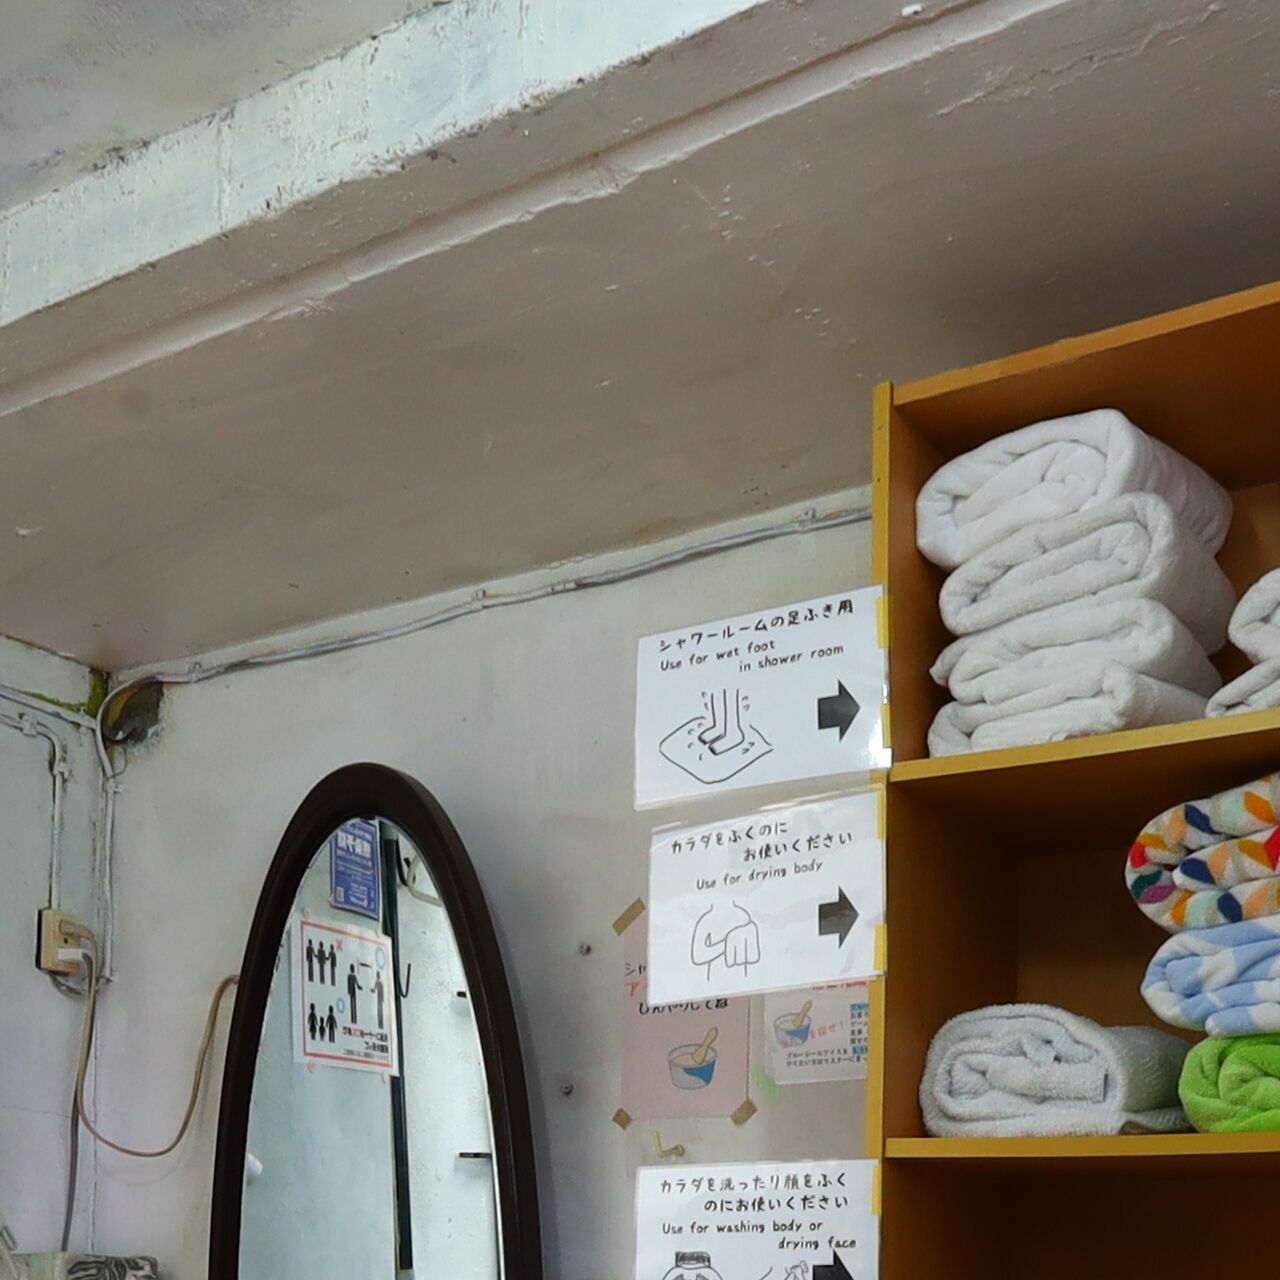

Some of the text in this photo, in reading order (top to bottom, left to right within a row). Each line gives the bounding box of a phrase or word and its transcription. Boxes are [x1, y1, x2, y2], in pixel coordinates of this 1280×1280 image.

[659, 598, 854, 653] シャワールームの足ふき用
[660, 639, 776, 672] Use for wet foot
[738, 644, 845, 673] in shower room
[671, 821, 788, 856] カラダをふくのに
[743, 832, 853, 863] お使いください
[696, 858, 823, 891] Use for drying body
[660, 1171, 848, 1194] カラダを洗ったり顔をふく
[704, 1194, 849, 1213] のにお使いください
[662, 1219, 823, 1235] Use for washing body or
[778, 1235, 857, 1251] drying face
